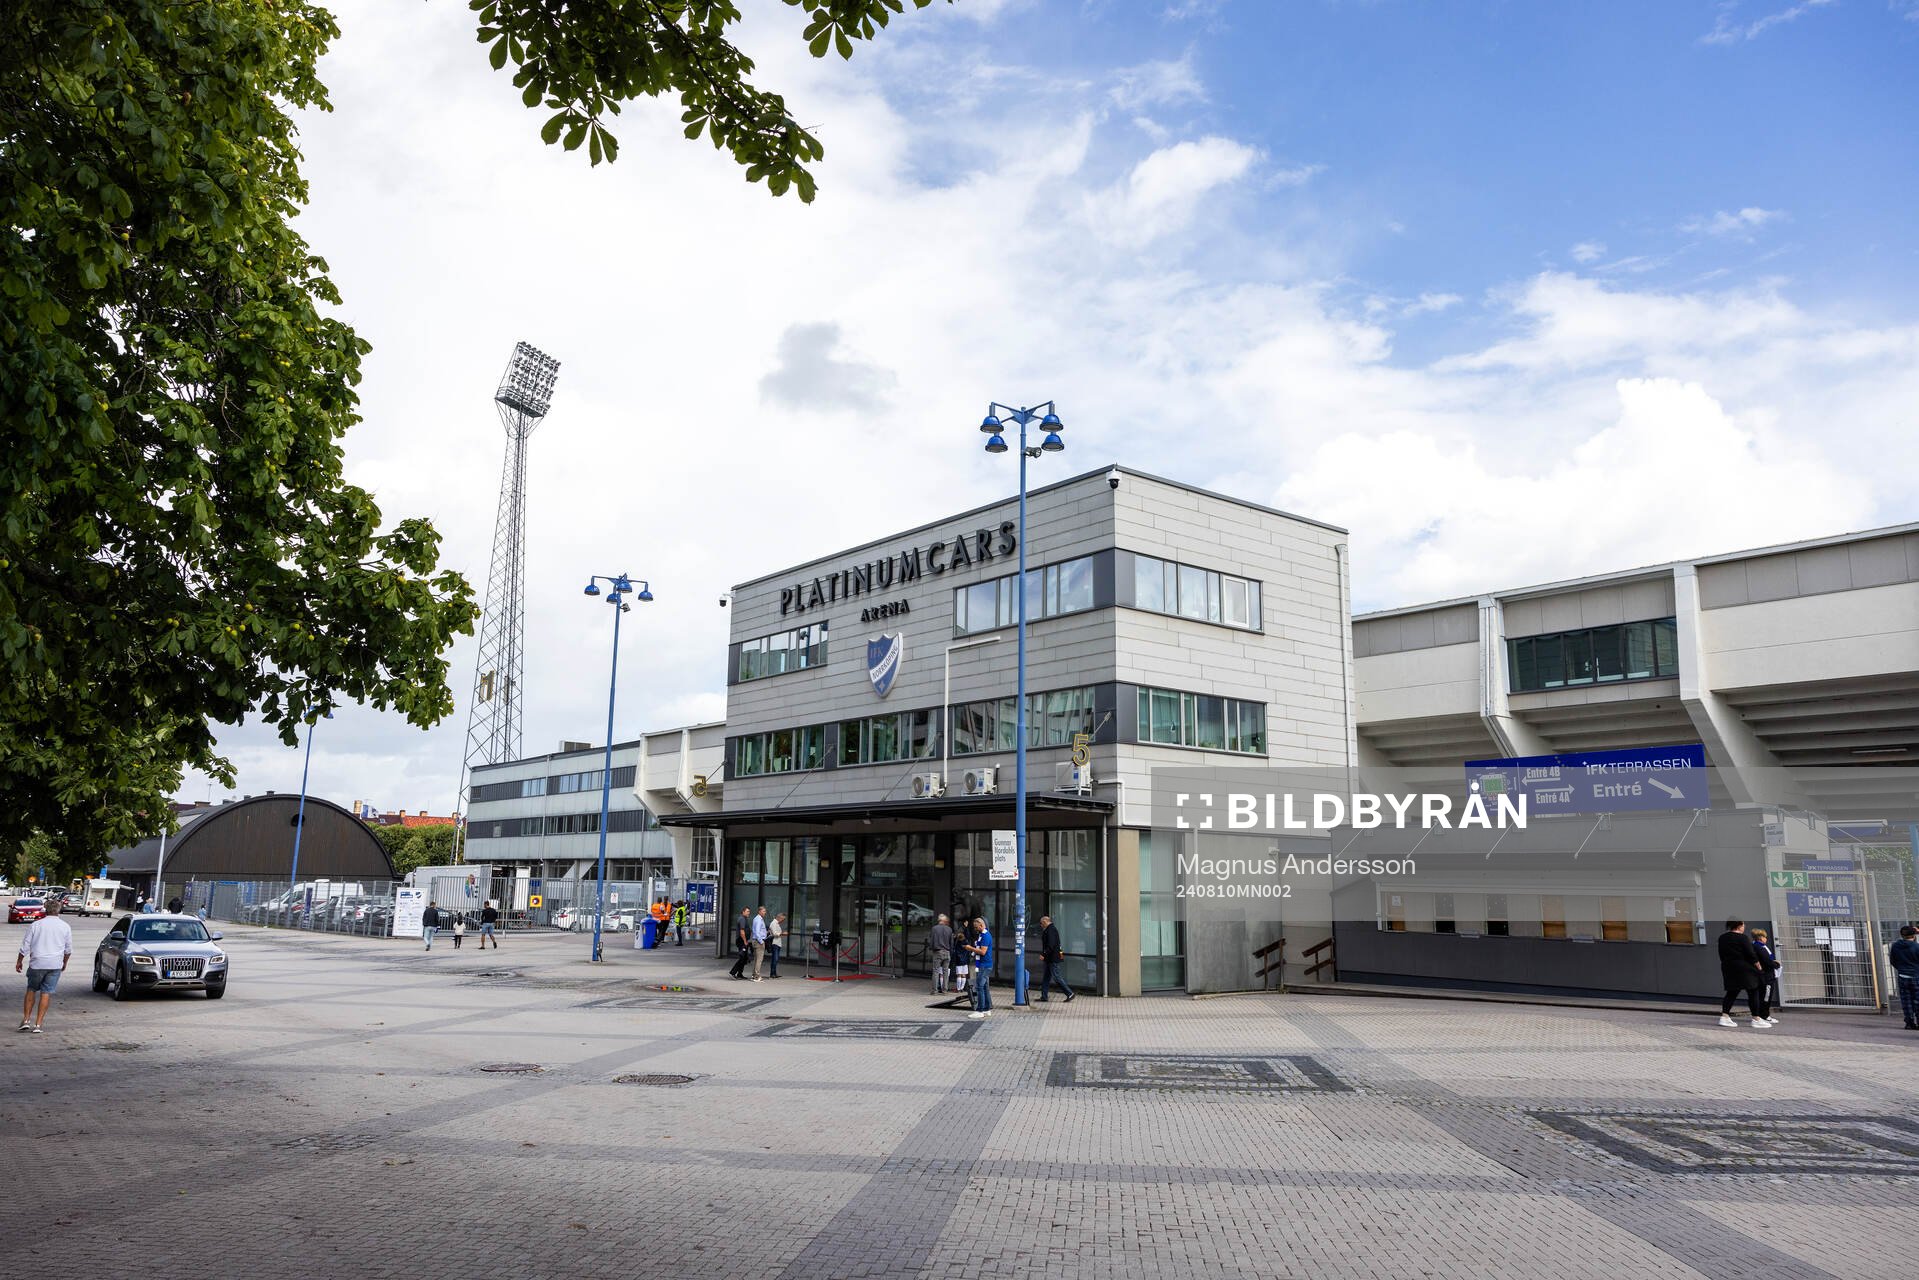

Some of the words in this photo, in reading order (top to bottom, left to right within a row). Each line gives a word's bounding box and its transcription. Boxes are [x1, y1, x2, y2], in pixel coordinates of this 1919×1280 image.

[780, 521, 1016, 615] PLATINUMCARS
[860, 599, 910, 622] ARENA
[1073, 733, 1090, 766] 5
[1527, 768, 1547, 778] Entré
[1549, 766, 1560, 777] 4B
[1536, 792, 1557, 804] Entré
[1559, 791, 1570, 803] 4A
[1593, 781, 1642, 798] Entré
[1808, 895, 1834, 907] Entré
[1836, 895, 1850, 907] 4A
